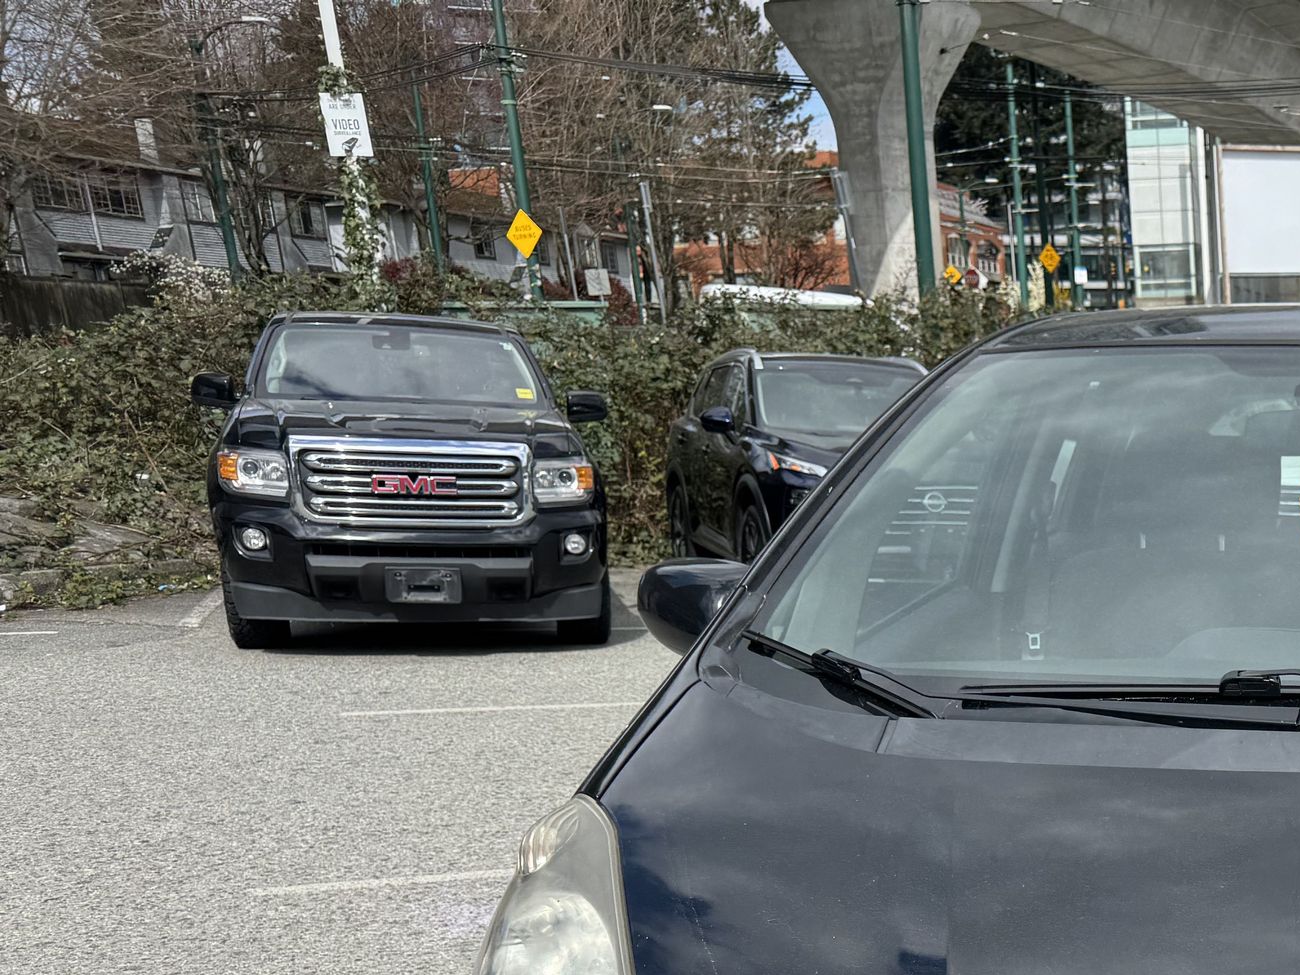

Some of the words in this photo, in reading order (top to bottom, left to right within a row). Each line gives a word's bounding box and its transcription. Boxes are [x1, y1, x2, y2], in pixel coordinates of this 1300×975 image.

[331, 118, 360, 130] VIDEO
[514, 223, 532, 232] BUSES
[512, 231, 537, 241] TURNING
[371, 474, 458, 495] GMC
